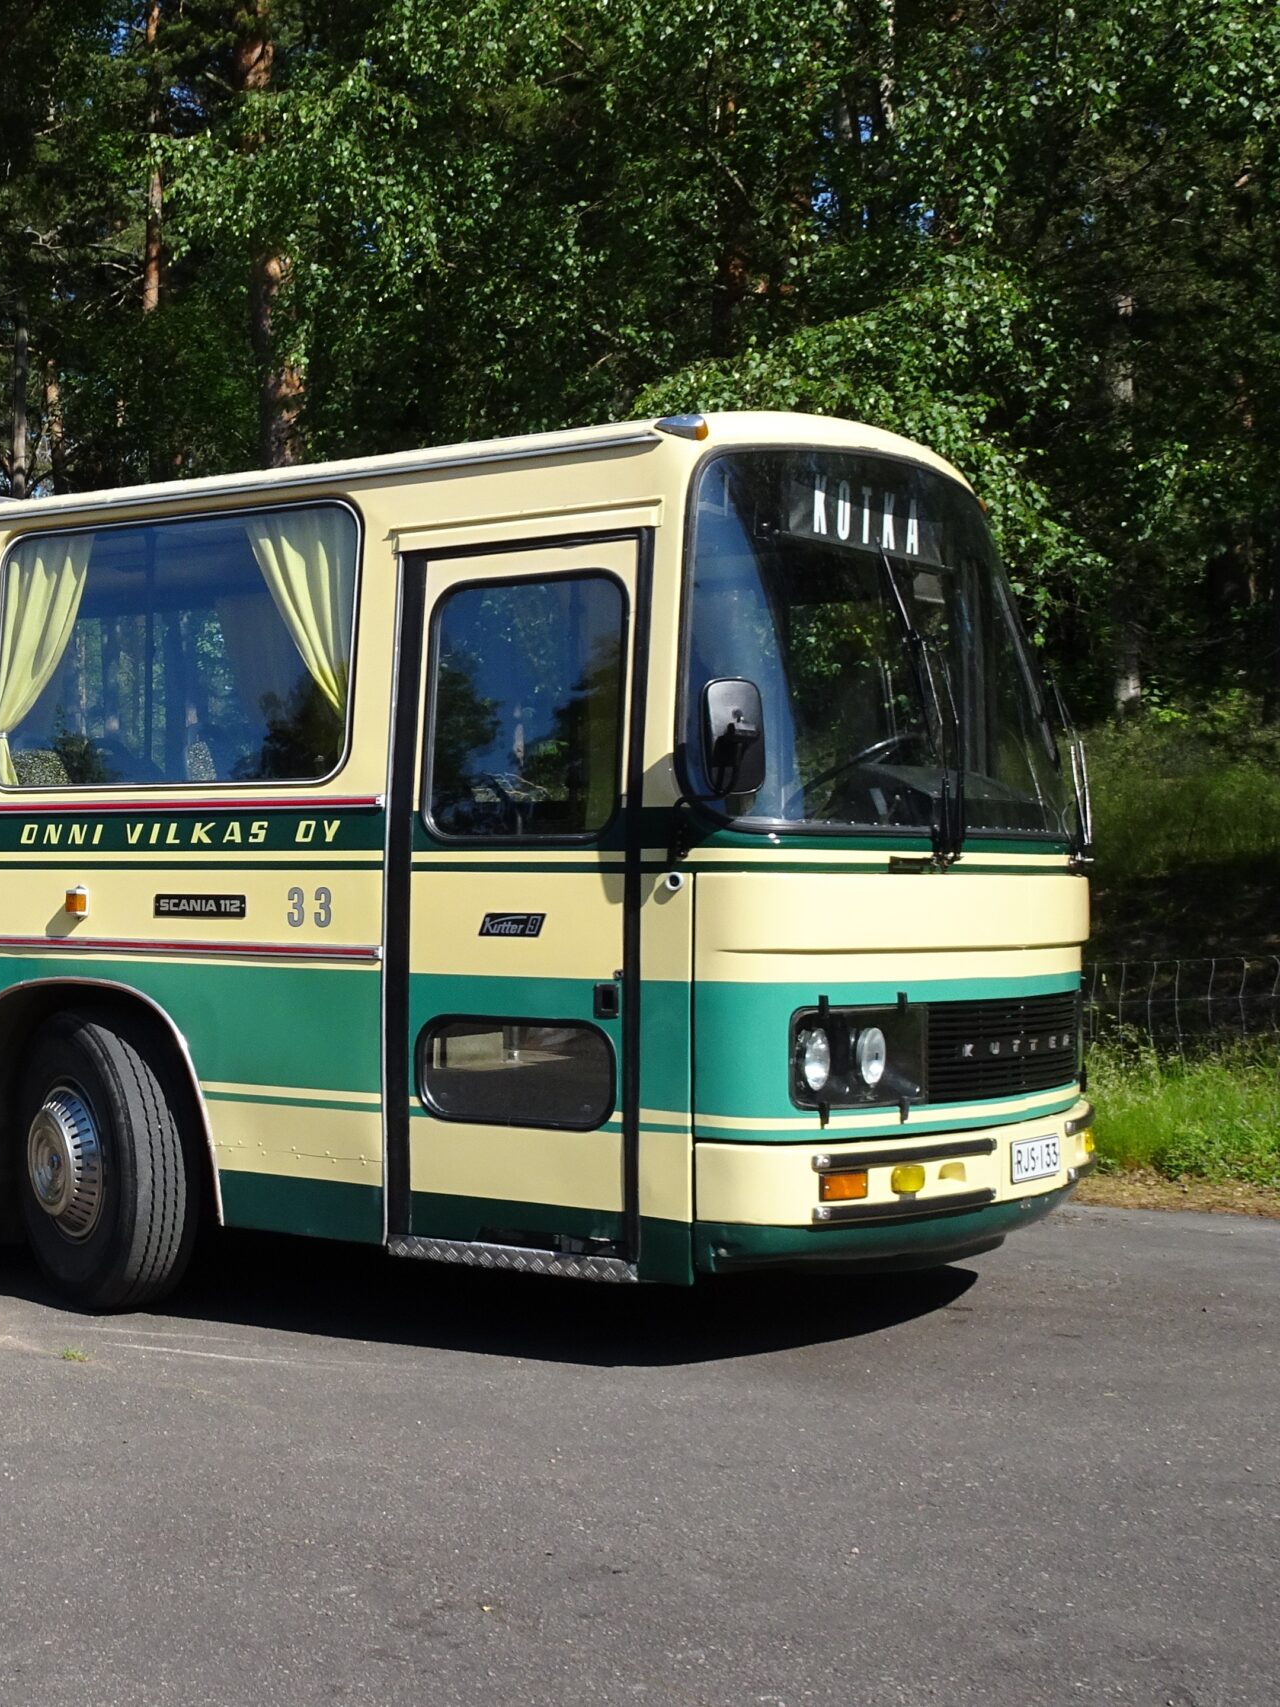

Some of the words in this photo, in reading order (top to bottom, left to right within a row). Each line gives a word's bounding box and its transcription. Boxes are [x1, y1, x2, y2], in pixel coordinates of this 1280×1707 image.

[813, 474, 919, 555] KOTKA
[20, 823, 104, 845] ONNI
[126, 821, 269, 844] VILKAS
[295, 820, 341, 843] OY
[159, 898, 217, 912] SCANIA
[219, 899, 241, 913] 112
[482, 916, 525, 934] Kutter
[962, 1034, 1070, 1057] KUTTER
[1016, 1142, 1059, 1175] RJS-133
